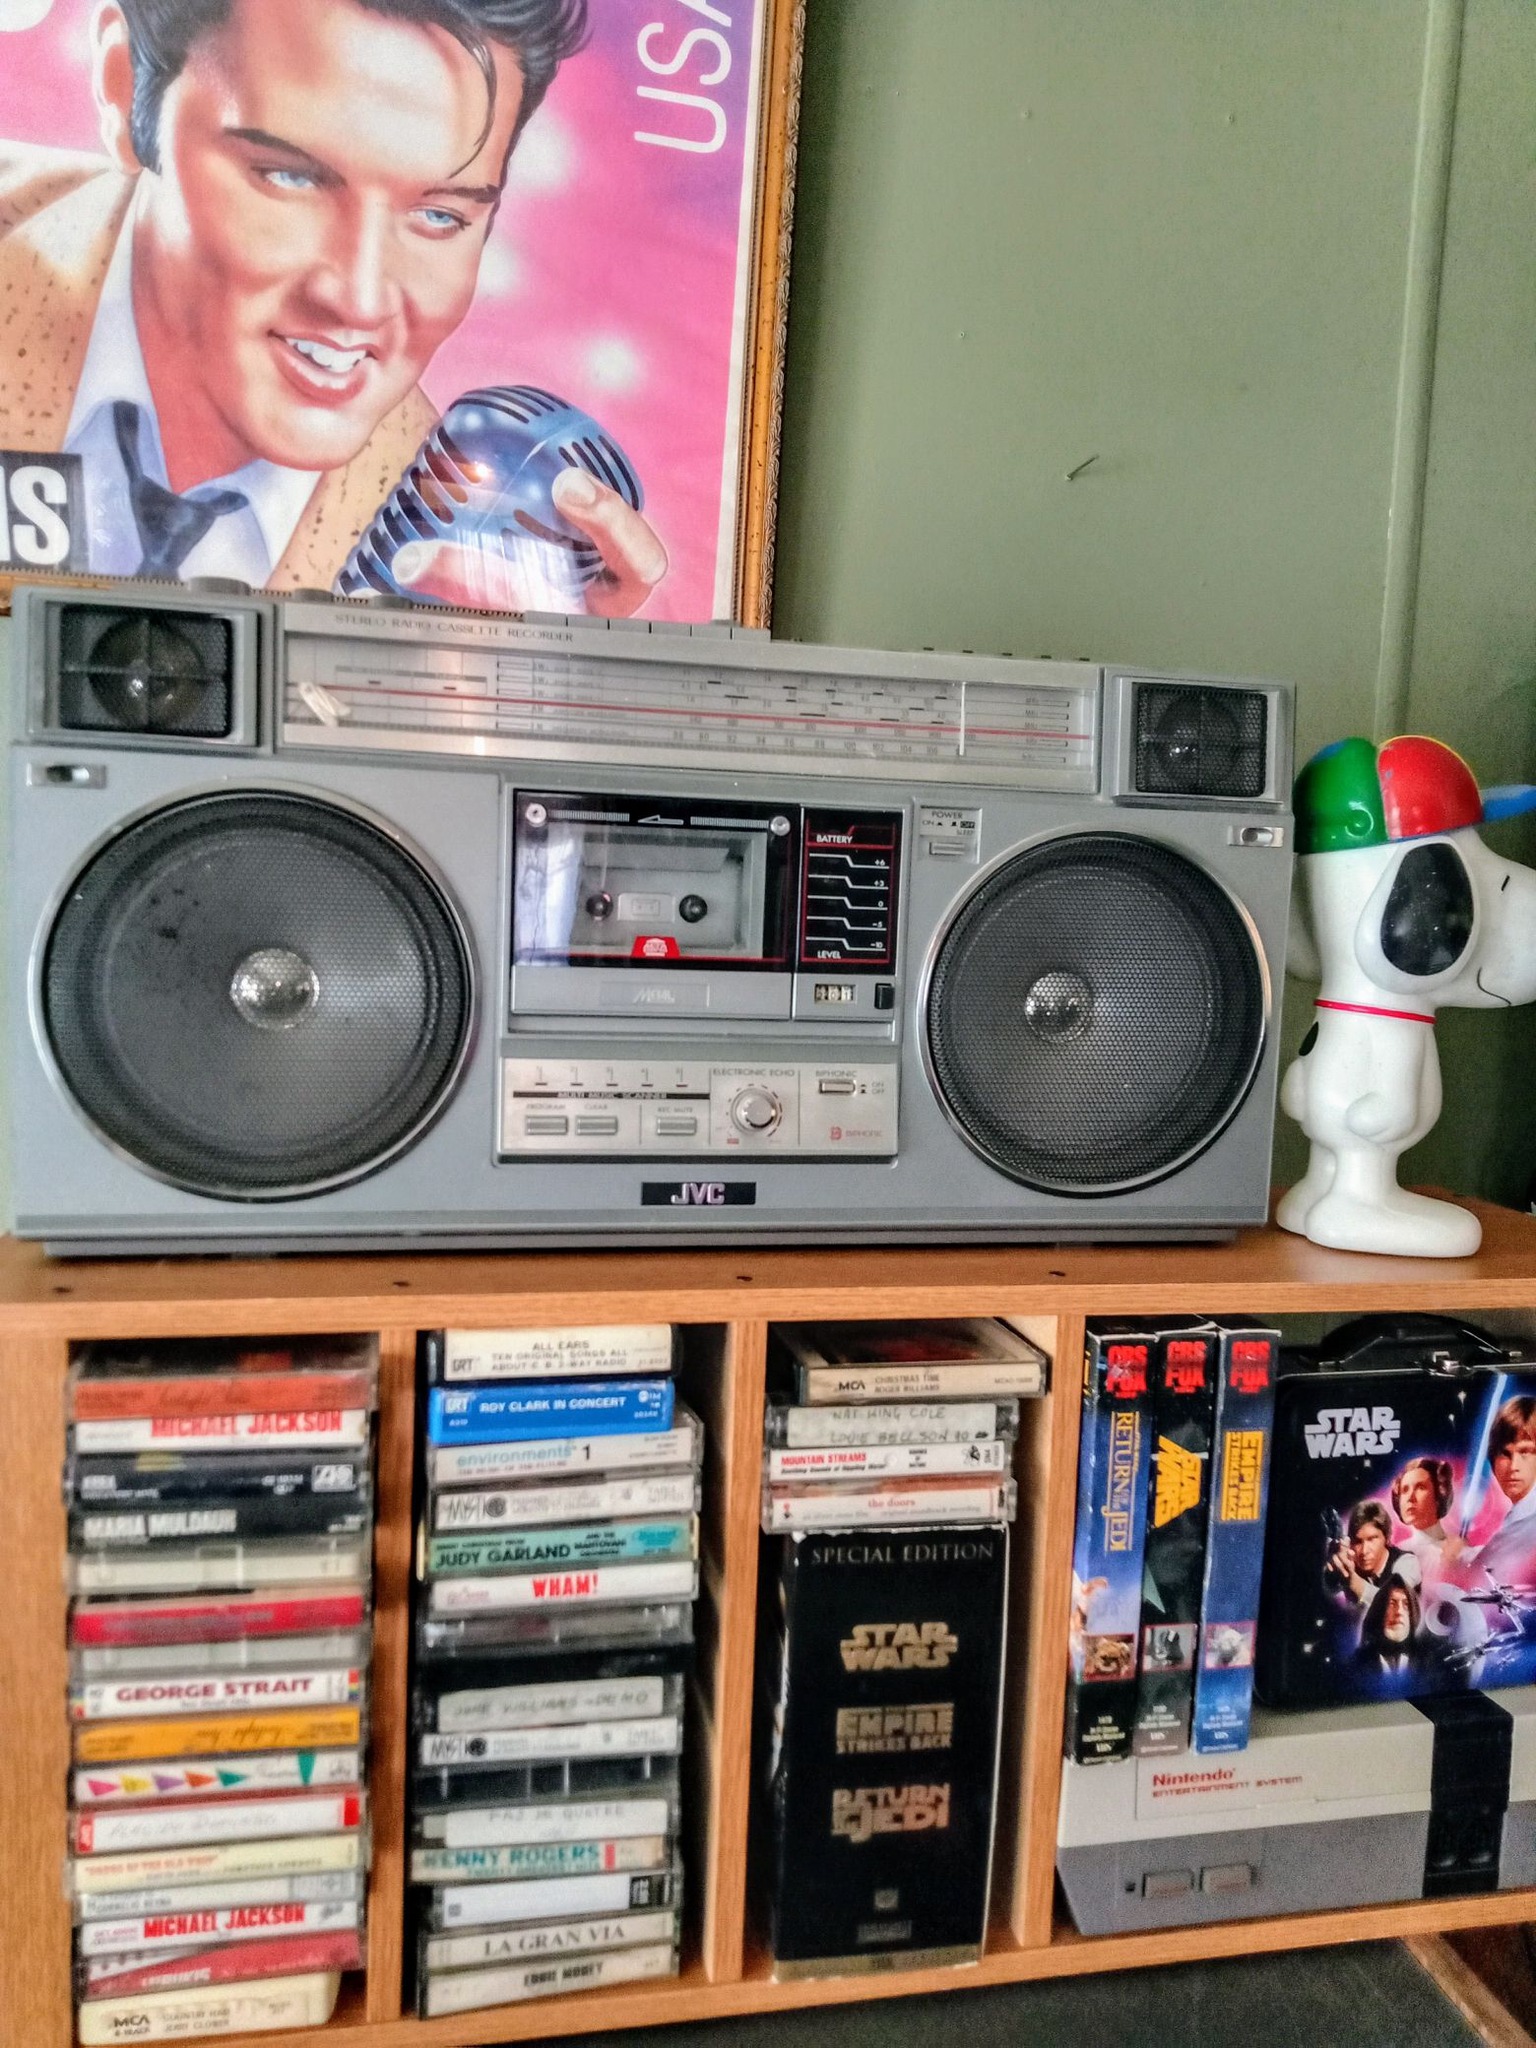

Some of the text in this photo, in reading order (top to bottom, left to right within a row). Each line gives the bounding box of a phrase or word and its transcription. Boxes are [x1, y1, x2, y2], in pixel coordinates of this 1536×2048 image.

[335, 614, 574, 642] STEREO RADIO CASSETTE RECORDER
[932, 811, 963, 819] POWER
[816, 834, 853, 844] BATTERY
[874, 858, 885, 867] +6
[817, 950, 842, 960] LEVEL
[712, 1068, 796, 1077] ELECTRONIC ECHO
[815, 1069, 858, 1078] BIPHONIC
[671, 1182, 725, 1204] JVC
[532, 1341, 554, 1351] ALL
[492, 1361, 527, 1371] ABOUT
[838, 1380, 865, 1391] MCA
[508, 1399, 551, 1413] CLARK
[553, 1398, 567, 1411] IN
[569, 1396, 627, 1410] CONCERT
[248, 1409, 342, 1435] JACKSON
[1304, 1406, 1401, 1434] STAR
[1114, 1411, 1139, 1491] RETURN
[1305, 1428, 1401, 1459] WARS
[457, 1444, 591, 1469] environments 1
[781, 1452, 867, 1467] MOUNTAIN STREAMS
[867, 1497, 916, 1508] the doors
[437, 1552, 480, 1568] JUDY
[487, 1543, 571, 1563] GARLAND
[812, 1542, 995, 1564] SPECIAL EDITION
[532, 1573, 599, 1598] WHAM!
[841, 1621, 958, 1648] STAR
[841, 1643, 958, 1672] WARS
[116, 1678, 314, 1702] GEORGE STRAIT
[1152, 1775, 1303, 1798] ENTERTAINMENT SYSTEM
[1153, 1768, 1234, 1786] Nintendo
[423, 1847, 502, 1870] KENNY
[509, 1841, 599, 1865] ROGERS
[144, 1911, 218, 1939] MICHAEL
[225, 1902, 305, 1930] JACKSON
[484, 1921, 626, 1957] LA GRAN VIA
[113, 2014, 150, 2028] MCA
